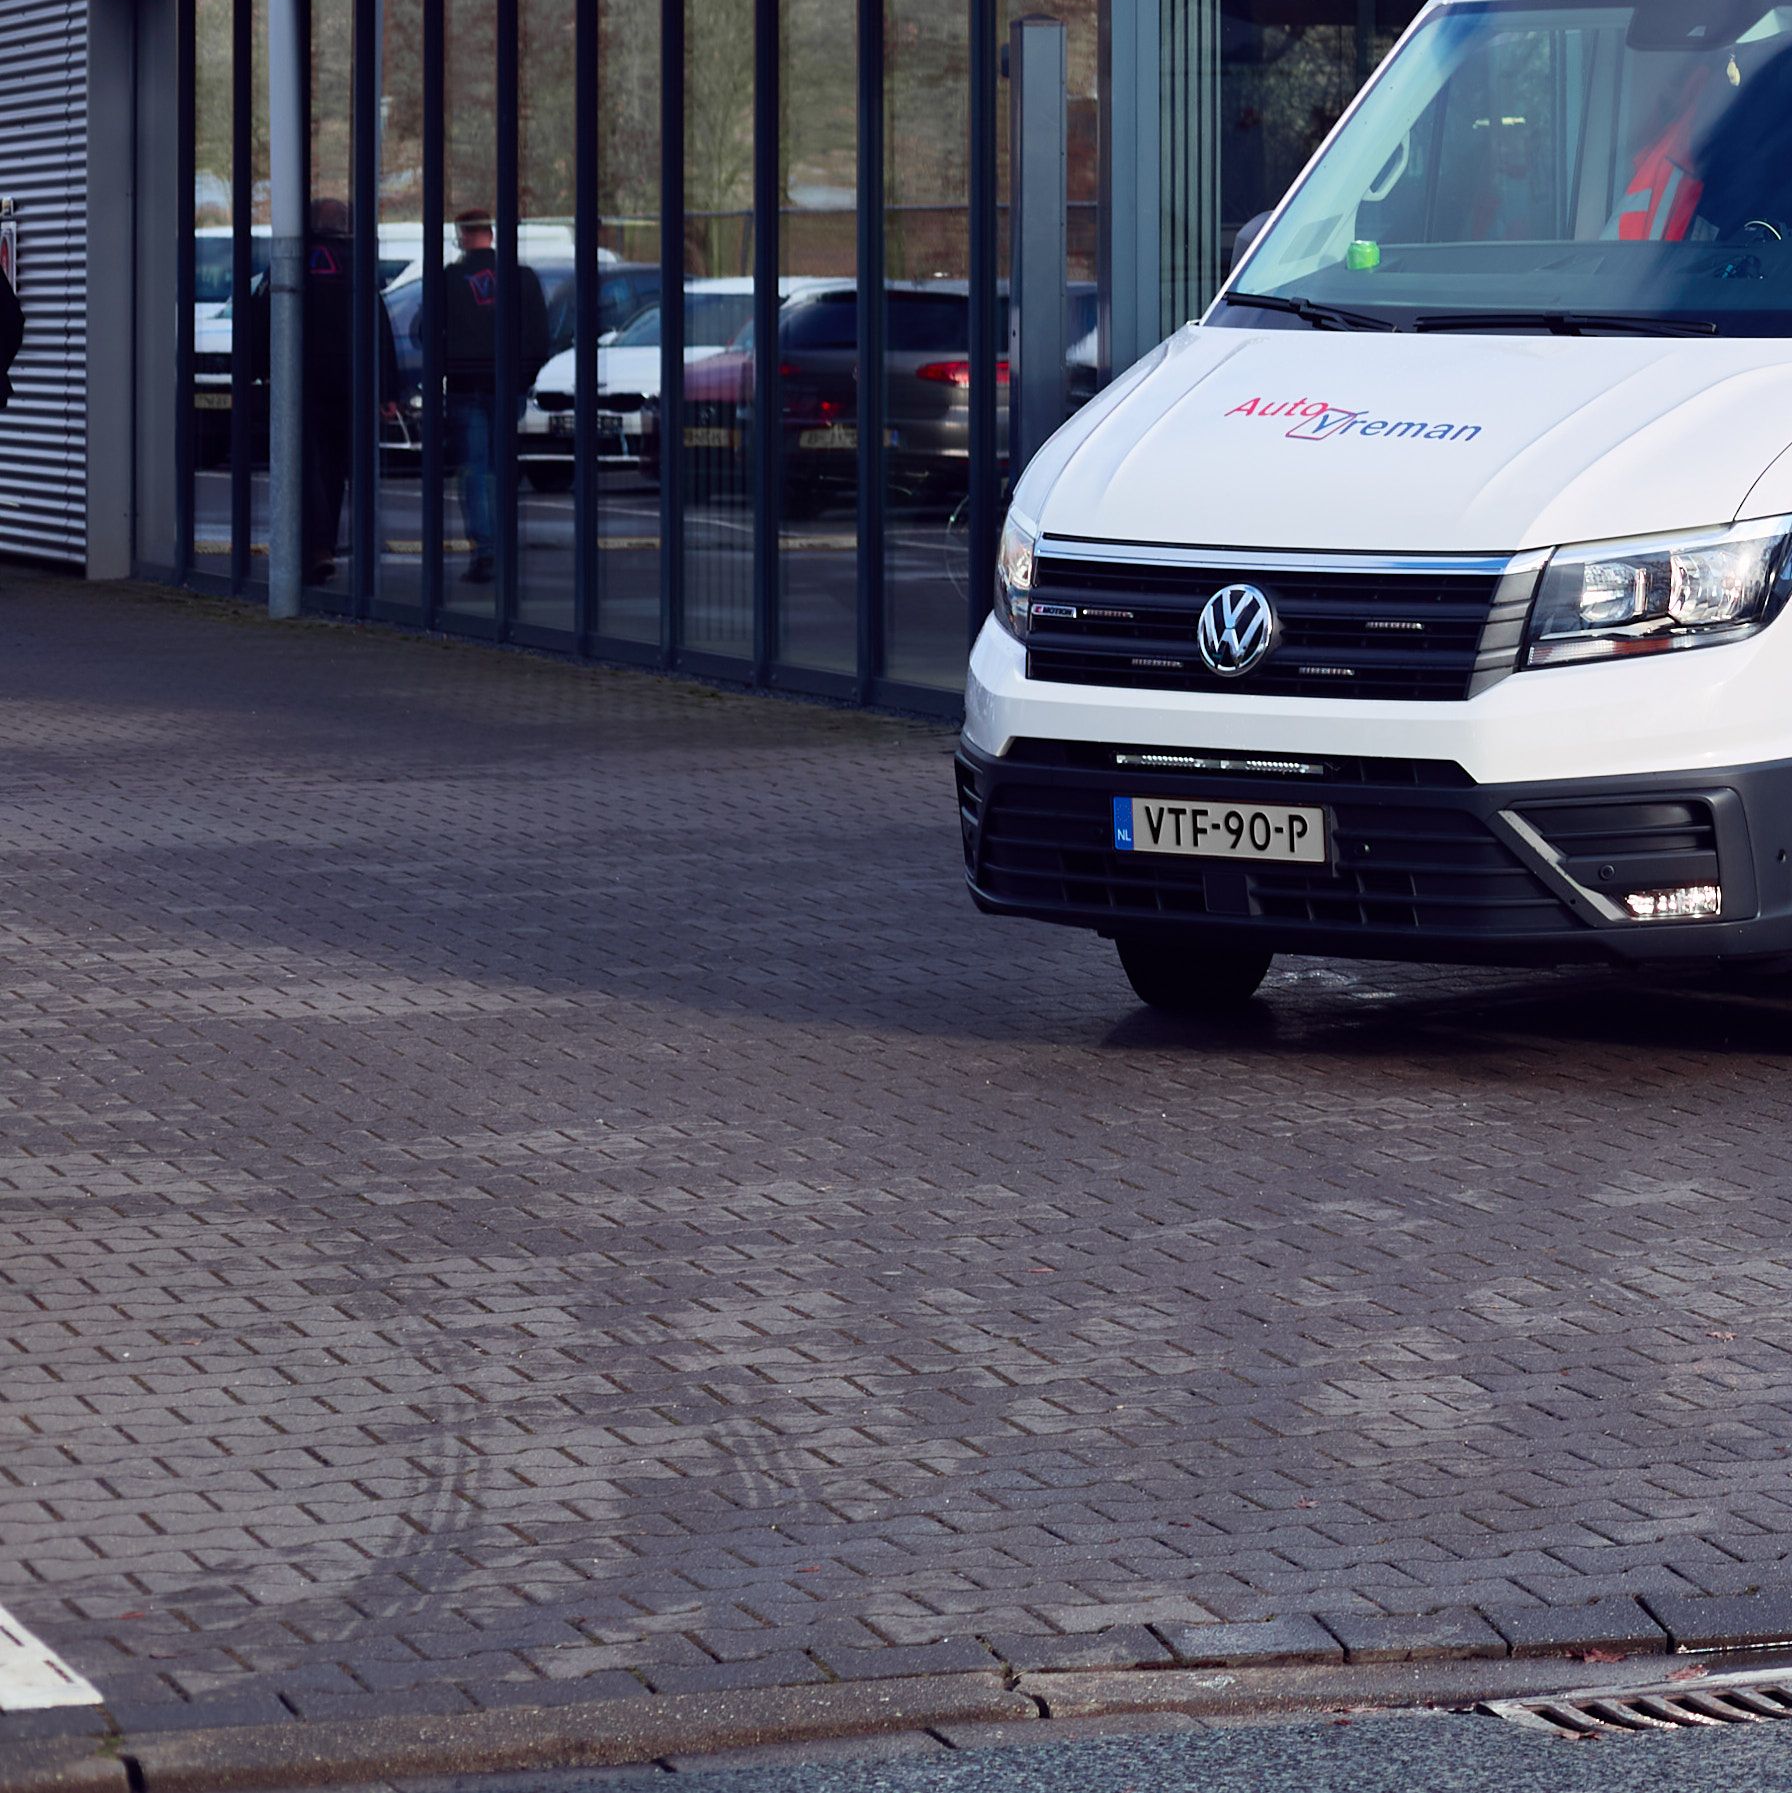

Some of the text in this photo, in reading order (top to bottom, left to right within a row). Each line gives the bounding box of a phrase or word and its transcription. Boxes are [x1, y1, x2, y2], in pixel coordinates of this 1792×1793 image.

[1224, 397, 1482, 442] Auto Vreman
[1117, 828, 1132, 842] NL
[1144, 805, 1309, 853] VTF-90-P
